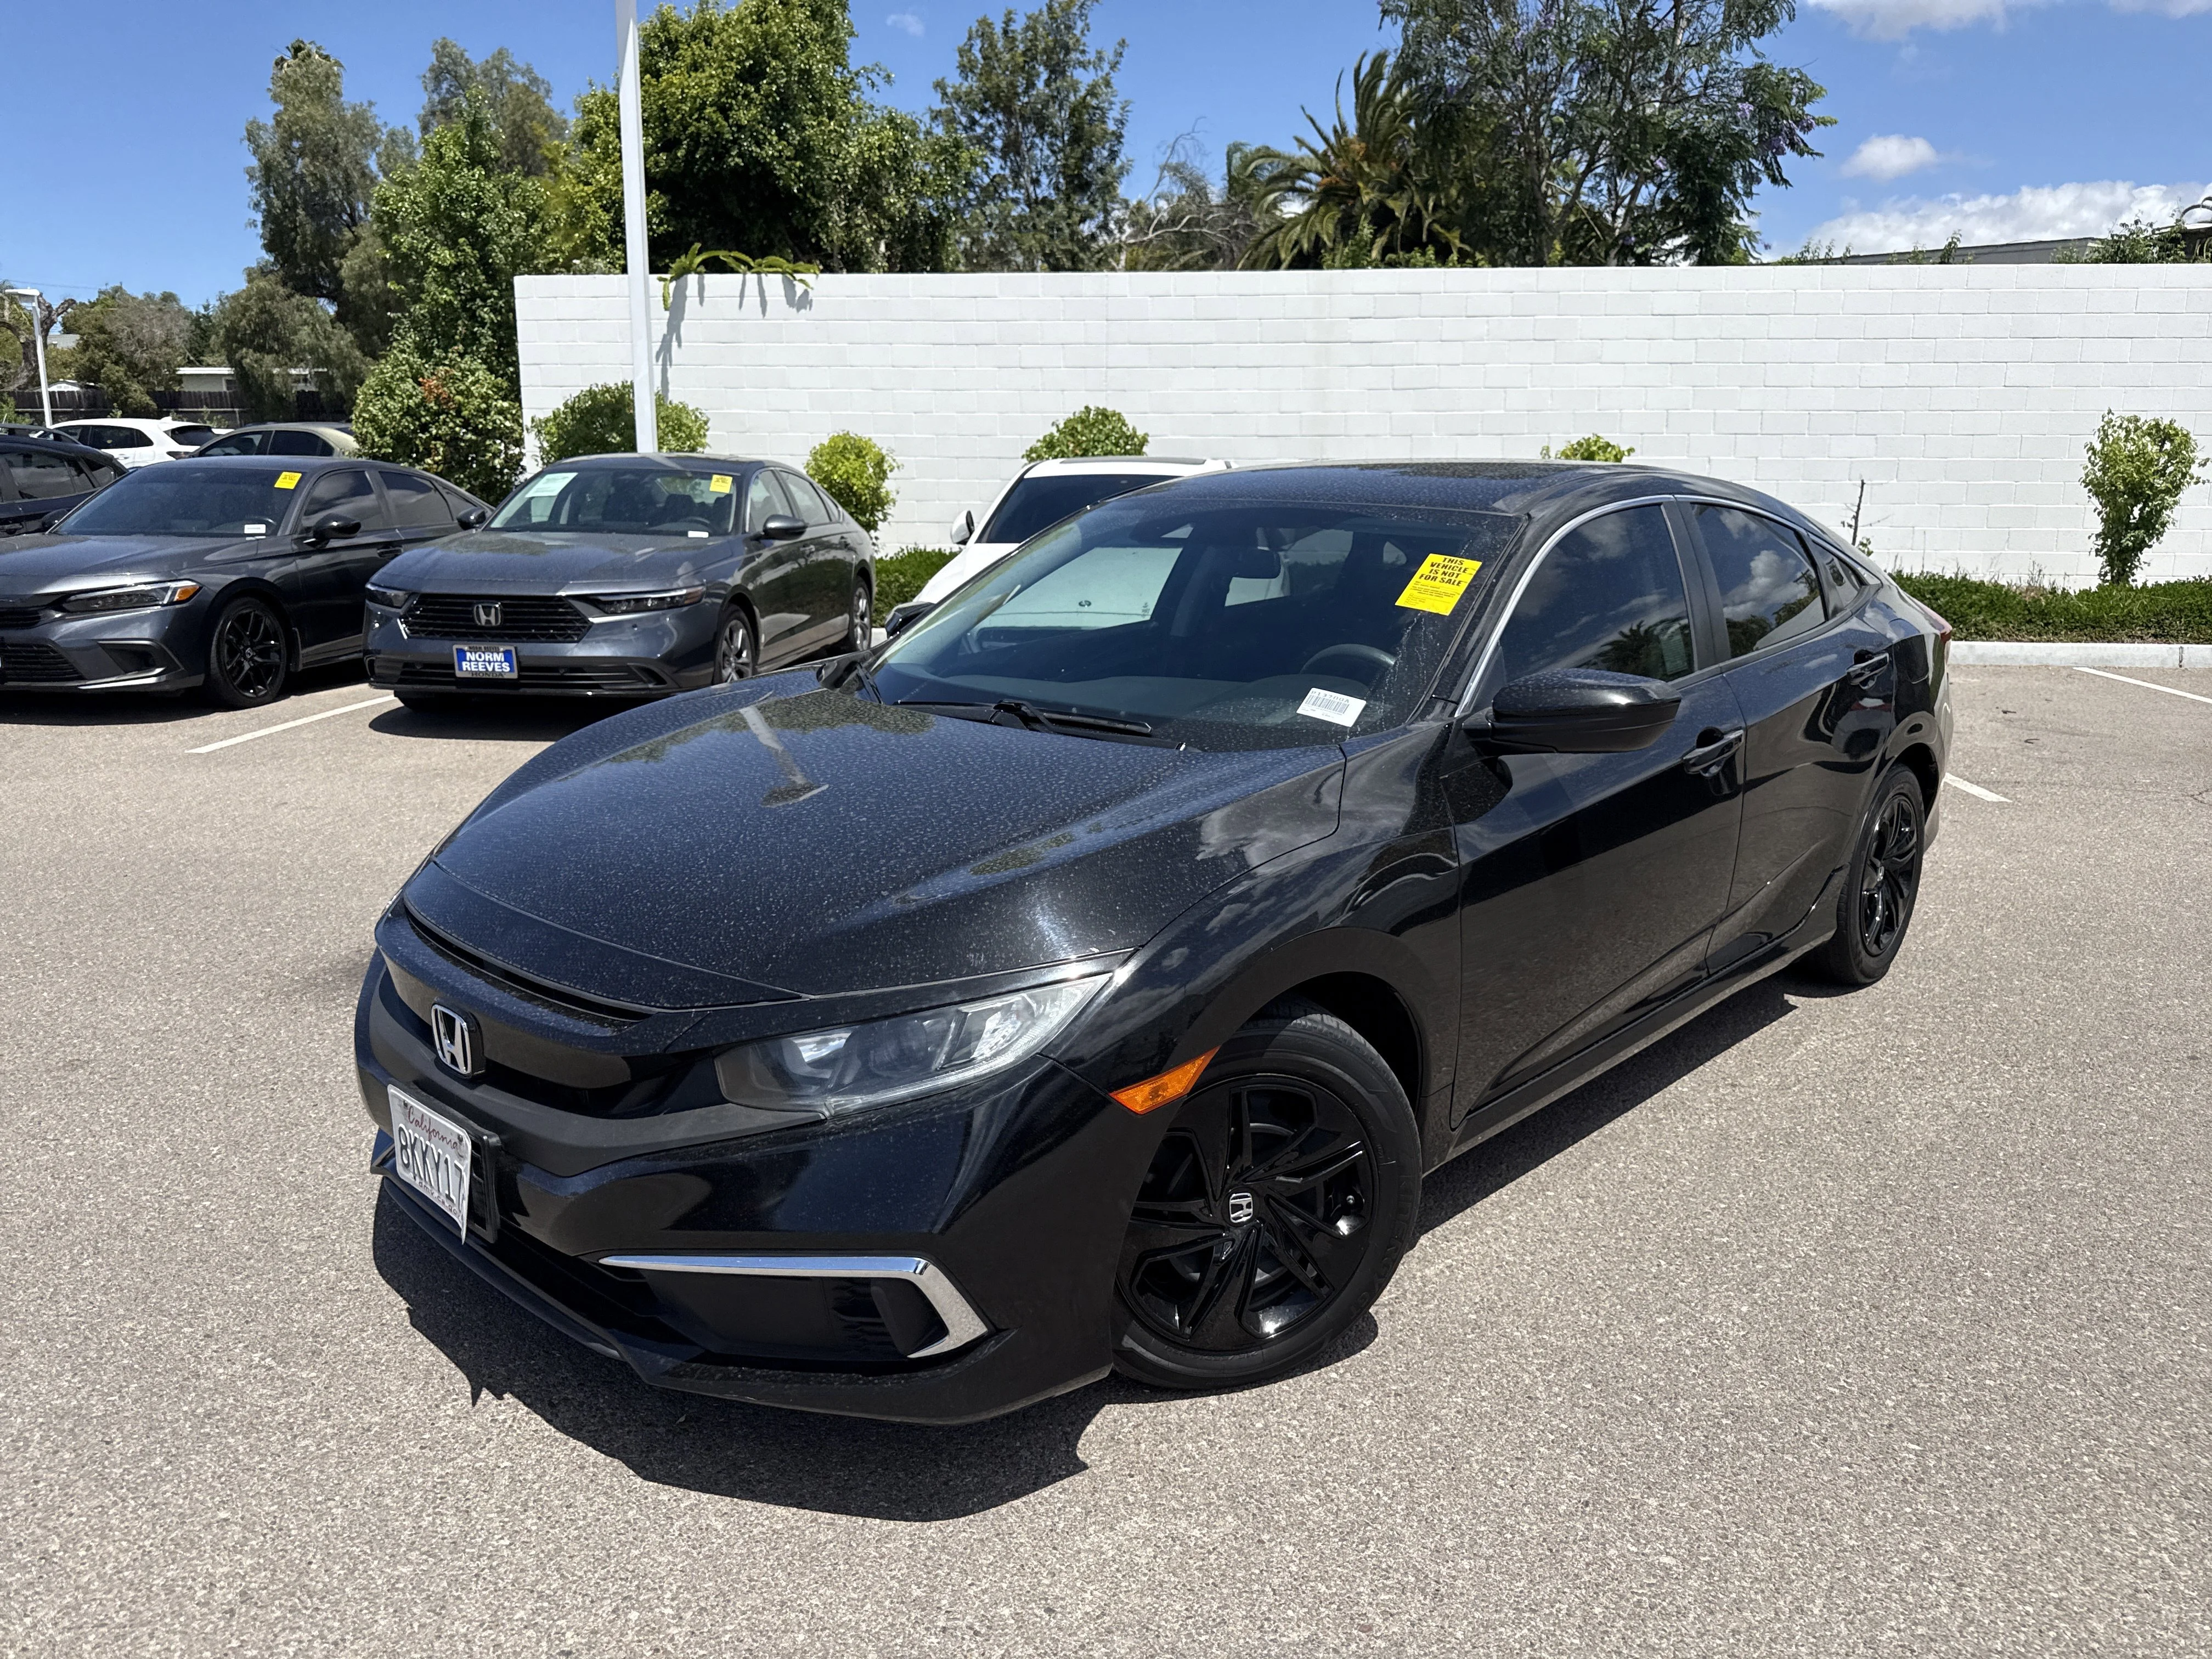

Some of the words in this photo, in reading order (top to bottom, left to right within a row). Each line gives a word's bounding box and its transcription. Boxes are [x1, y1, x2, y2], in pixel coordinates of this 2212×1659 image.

[1442, 557, 1465, 566] THIS
[1430, 562, 1469, 573] VEHICLE
[1419, 573, 1438, 582] FOR
[1438, 577, 1463, 586] SALE
[1441, 571, 1462, 579] NOT
[466, 652, 504, 662] NORM
[461, 662, 510, 672] REEVES
[408, 1105, 458, 1150] California
[398, 1124, 466, 1217] 8KKY17
[419, 1181, 460, 1218] dmv.ca.go
